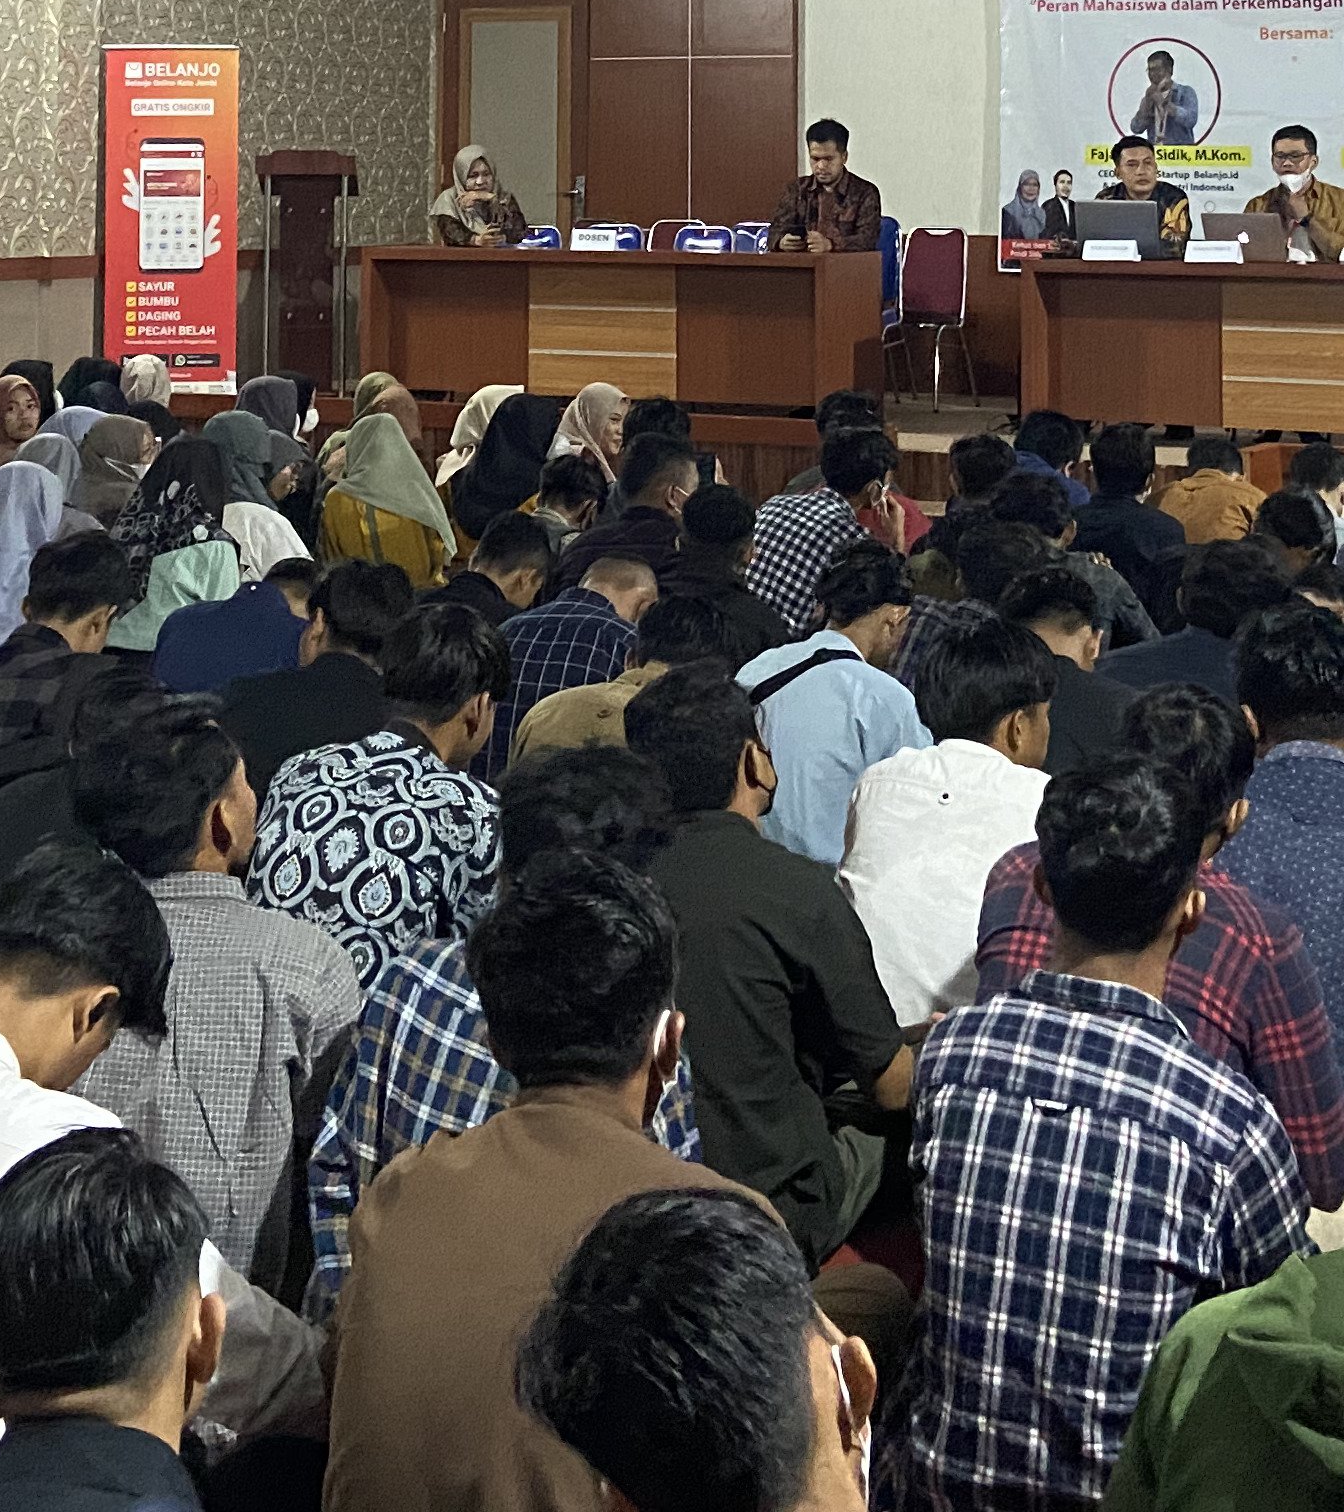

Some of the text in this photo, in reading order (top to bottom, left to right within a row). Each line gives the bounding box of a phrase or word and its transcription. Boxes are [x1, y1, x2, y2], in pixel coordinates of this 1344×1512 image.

[1259, 26, 1334, 40] Bersama:
[144, 62, 221, 77] BELANJO
[133, 103, 211, 112] GRATIS ONGKIR
[1195, 149, 1246, 162] M.Kom.
[1190, 183, 1235, 192] Indonesia
[578, 233, 610, 241] DOSEN
[138, 282, 175, 292] SAYUR
[138, 296, 179, 306] BUMBU
[138, 311, 181, 321] DAGING
[137, 325, 216, 336] PECAH BELAH
